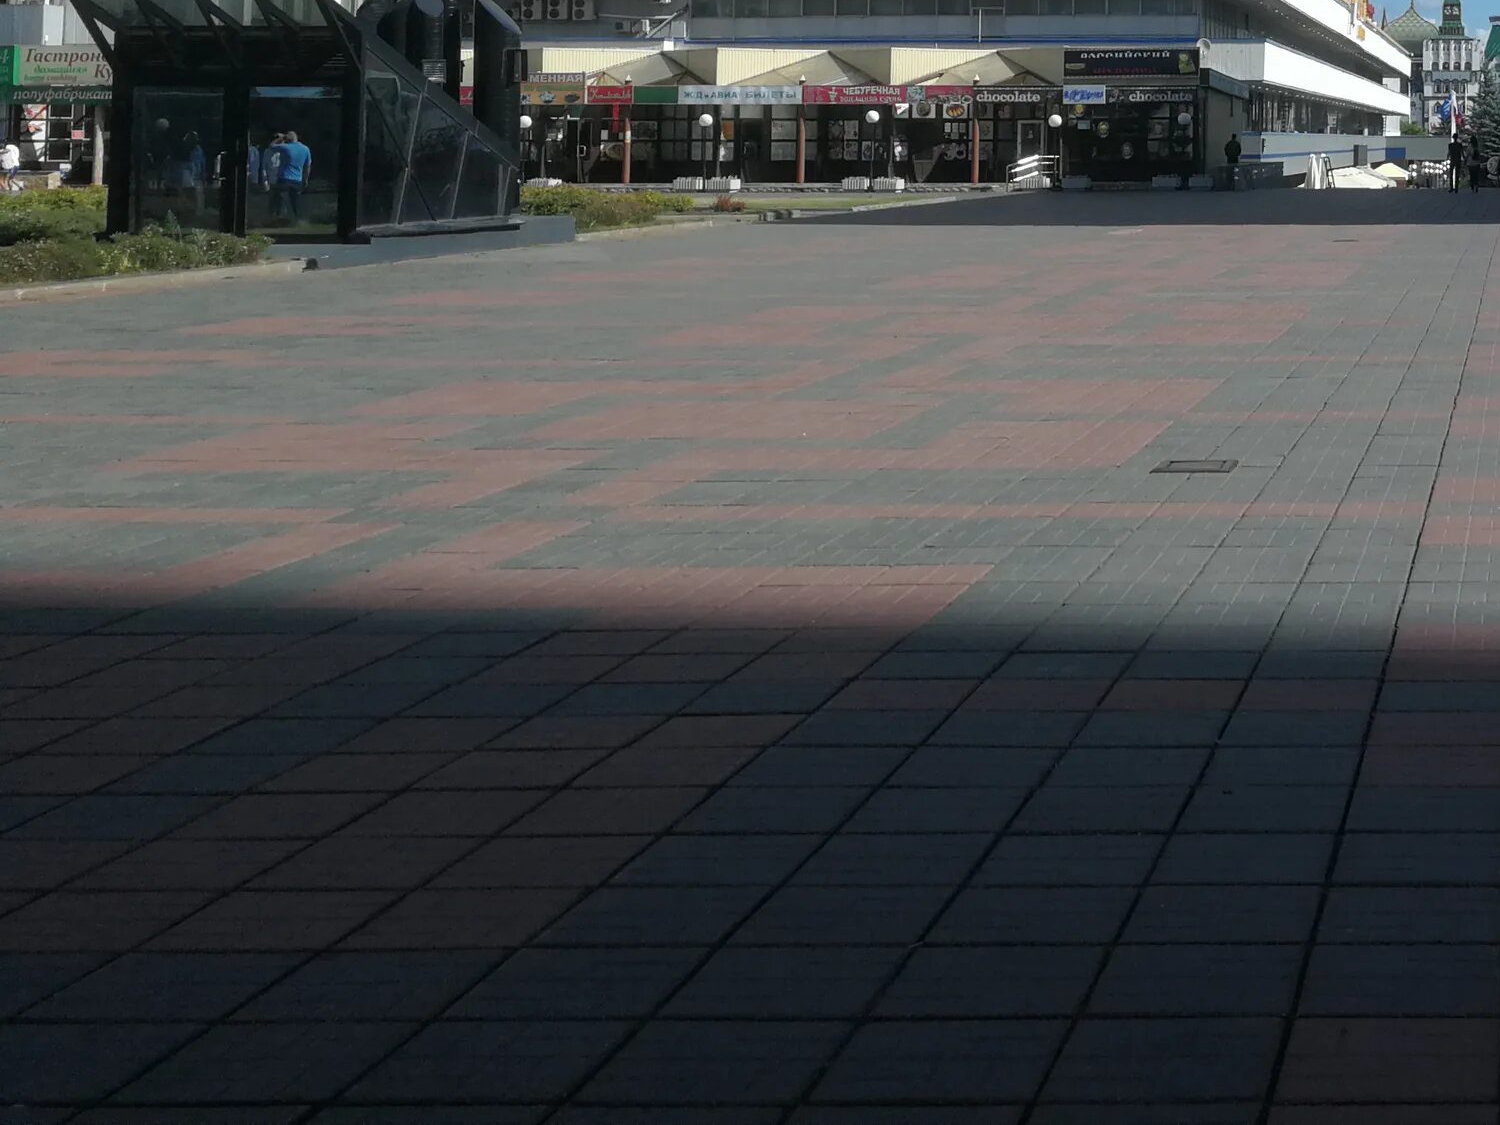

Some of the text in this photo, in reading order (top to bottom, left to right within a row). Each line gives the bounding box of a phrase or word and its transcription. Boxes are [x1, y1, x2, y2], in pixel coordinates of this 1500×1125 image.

[710, 90, 738, 99] АВИА
[745, 90, 797, 99] БИЛЕТЫ
[843, 85, 900, 95] ЧЕБУРЕЧНАЯ
[976, 91, 1040, 102] chocolate
[1128, 91, 1193, 102] chocolate
